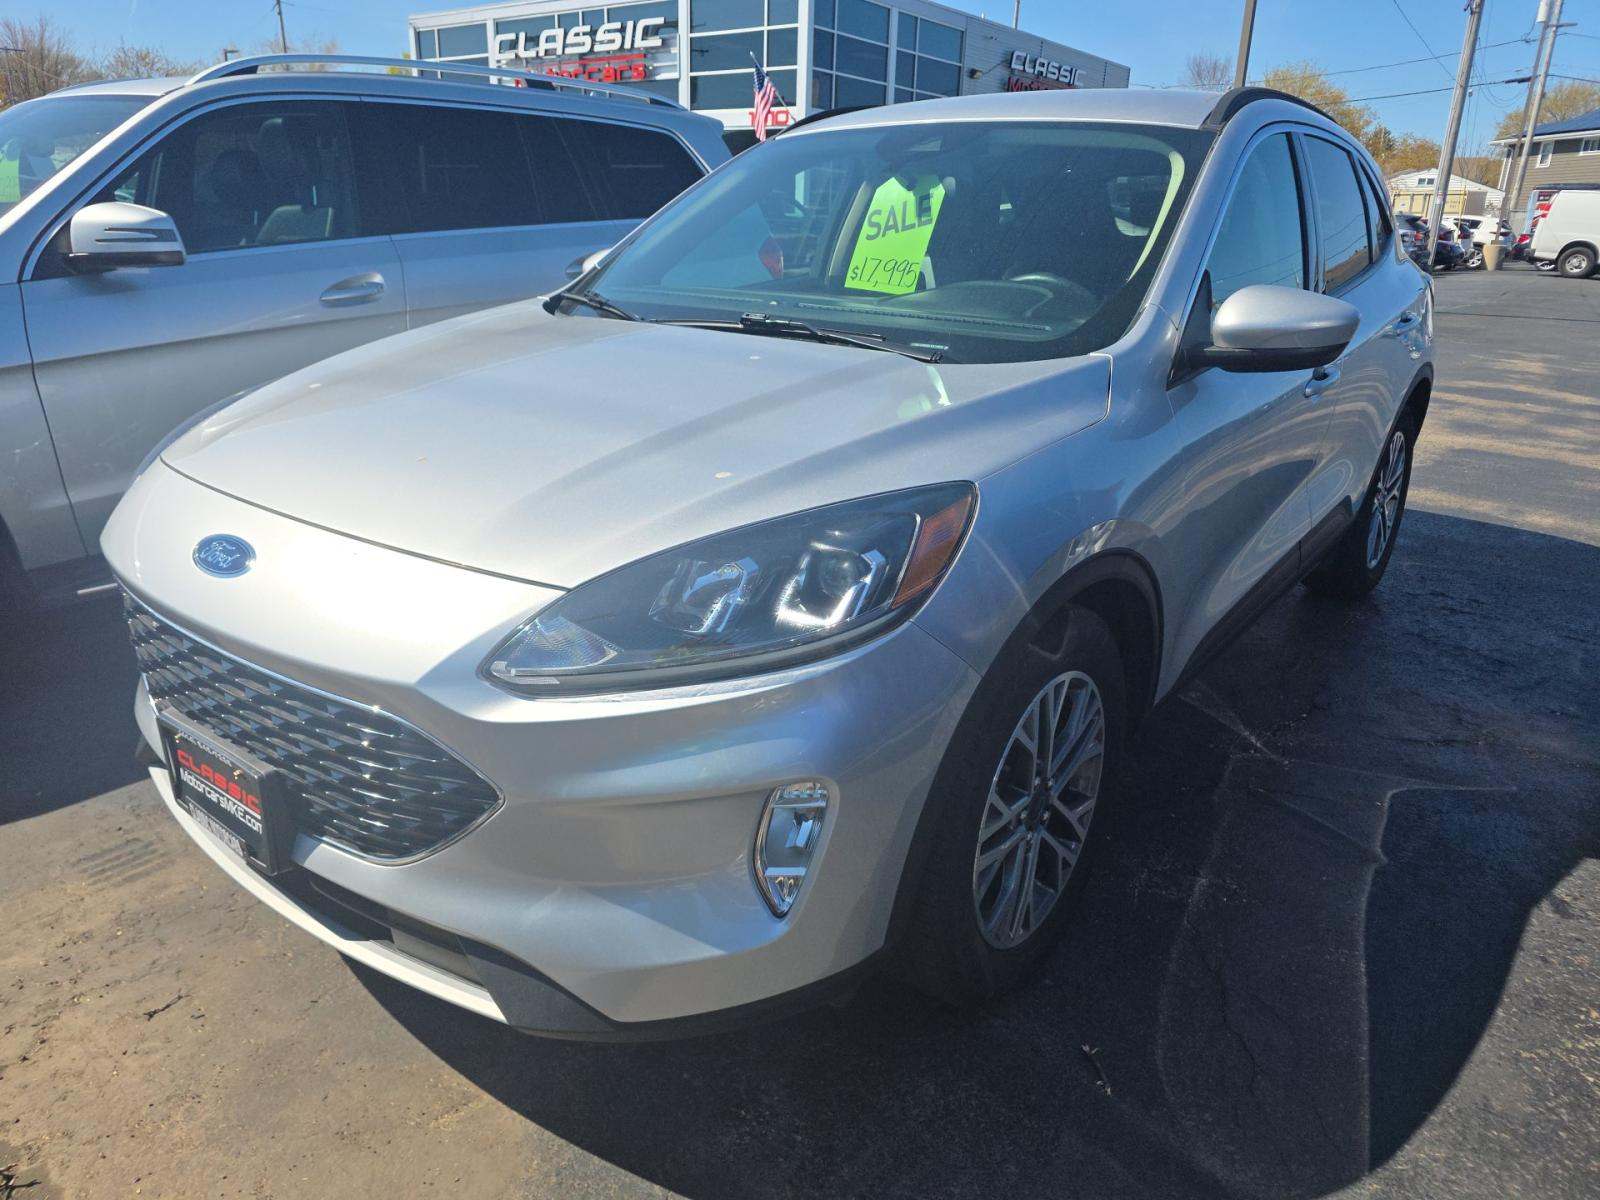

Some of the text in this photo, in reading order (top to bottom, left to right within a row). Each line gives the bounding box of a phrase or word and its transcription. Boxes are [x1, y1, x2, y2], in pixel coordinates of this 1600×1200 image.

[494, 16, 665, 60] CLASSIC
[1011, 50, 1088, 88] CLASSIC
[865, 193, 933, 241] SALE
[850, 256, 920, 288] $17,995
[199, 540, 241, 569] Ford
[176, 748, 262, 814] CLASSIC
